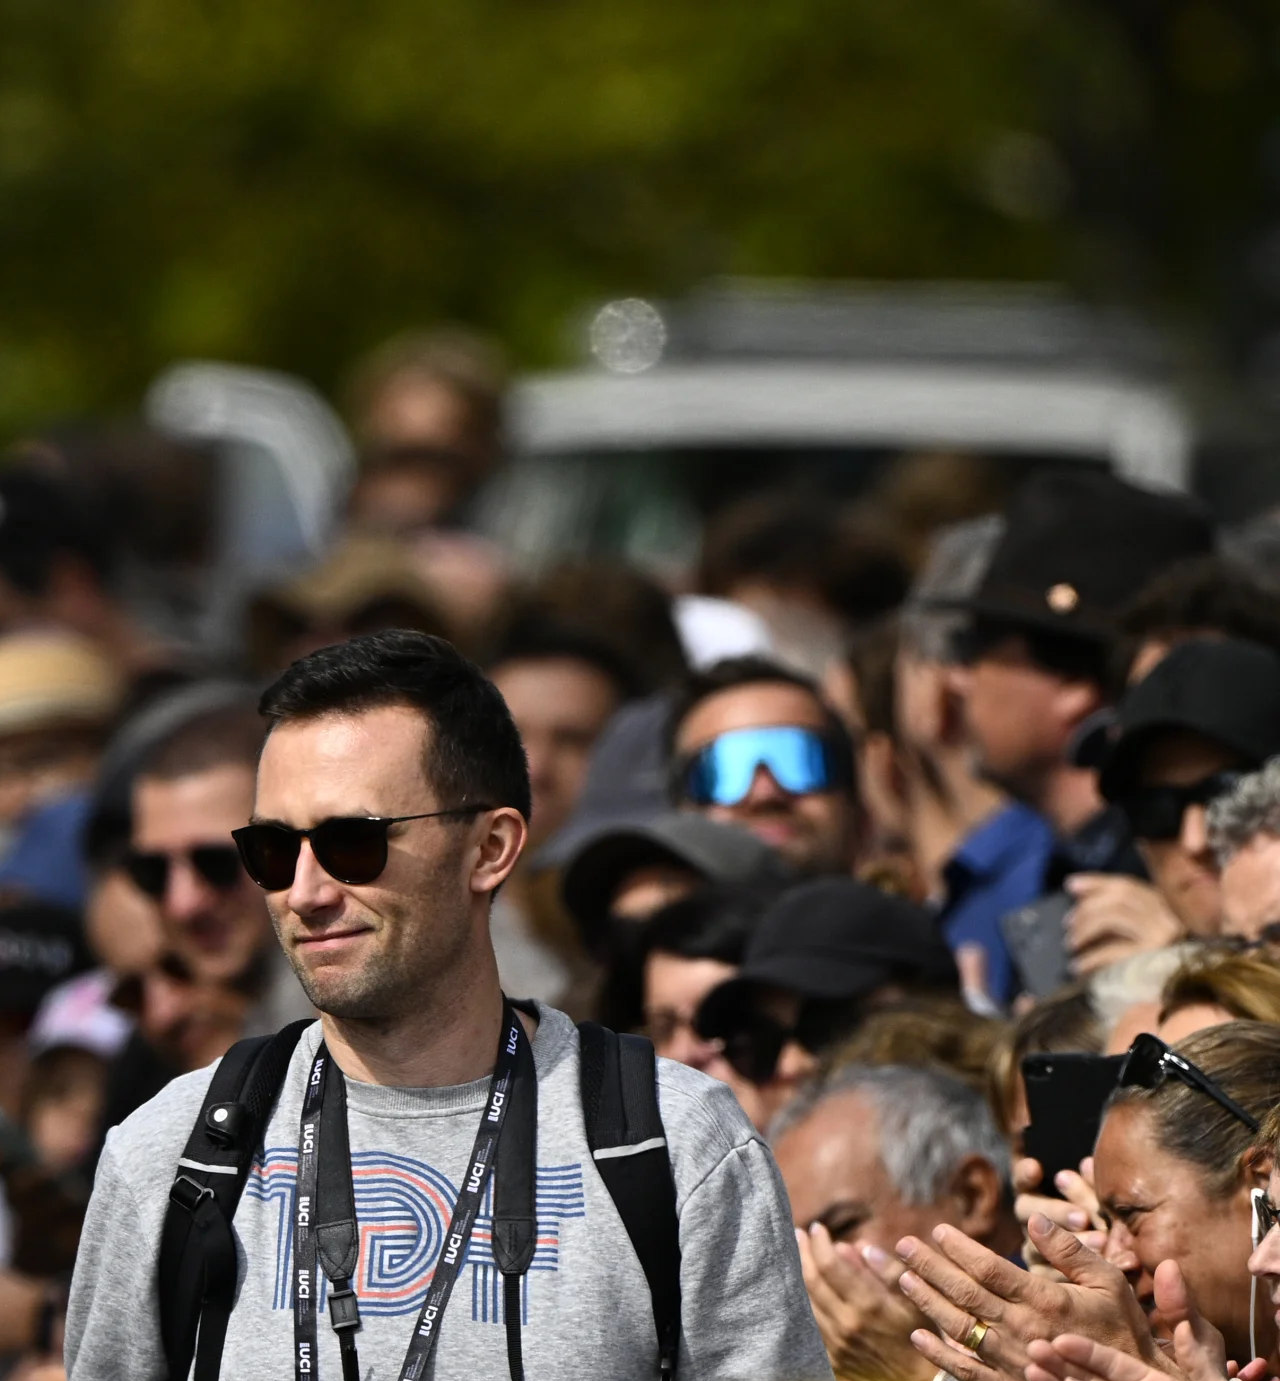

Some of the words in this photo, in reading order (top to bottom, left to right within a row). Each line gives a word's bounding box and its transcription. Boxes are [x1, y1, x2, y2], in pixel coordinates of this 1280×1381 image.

[488, 1091, 505, 1122] UCI
[303, 1123, 314, 1154] UCI
[467, 1162, 486, 1194] UCI
[298, 1196, 310, 1226] UCI
[443, 1233, 462, 1265] UCI
[298, 1270, 310, 1299] UCI
[419, 1305, 438, 1337] UCI
[299, 1342, 311, 1373] UCI
